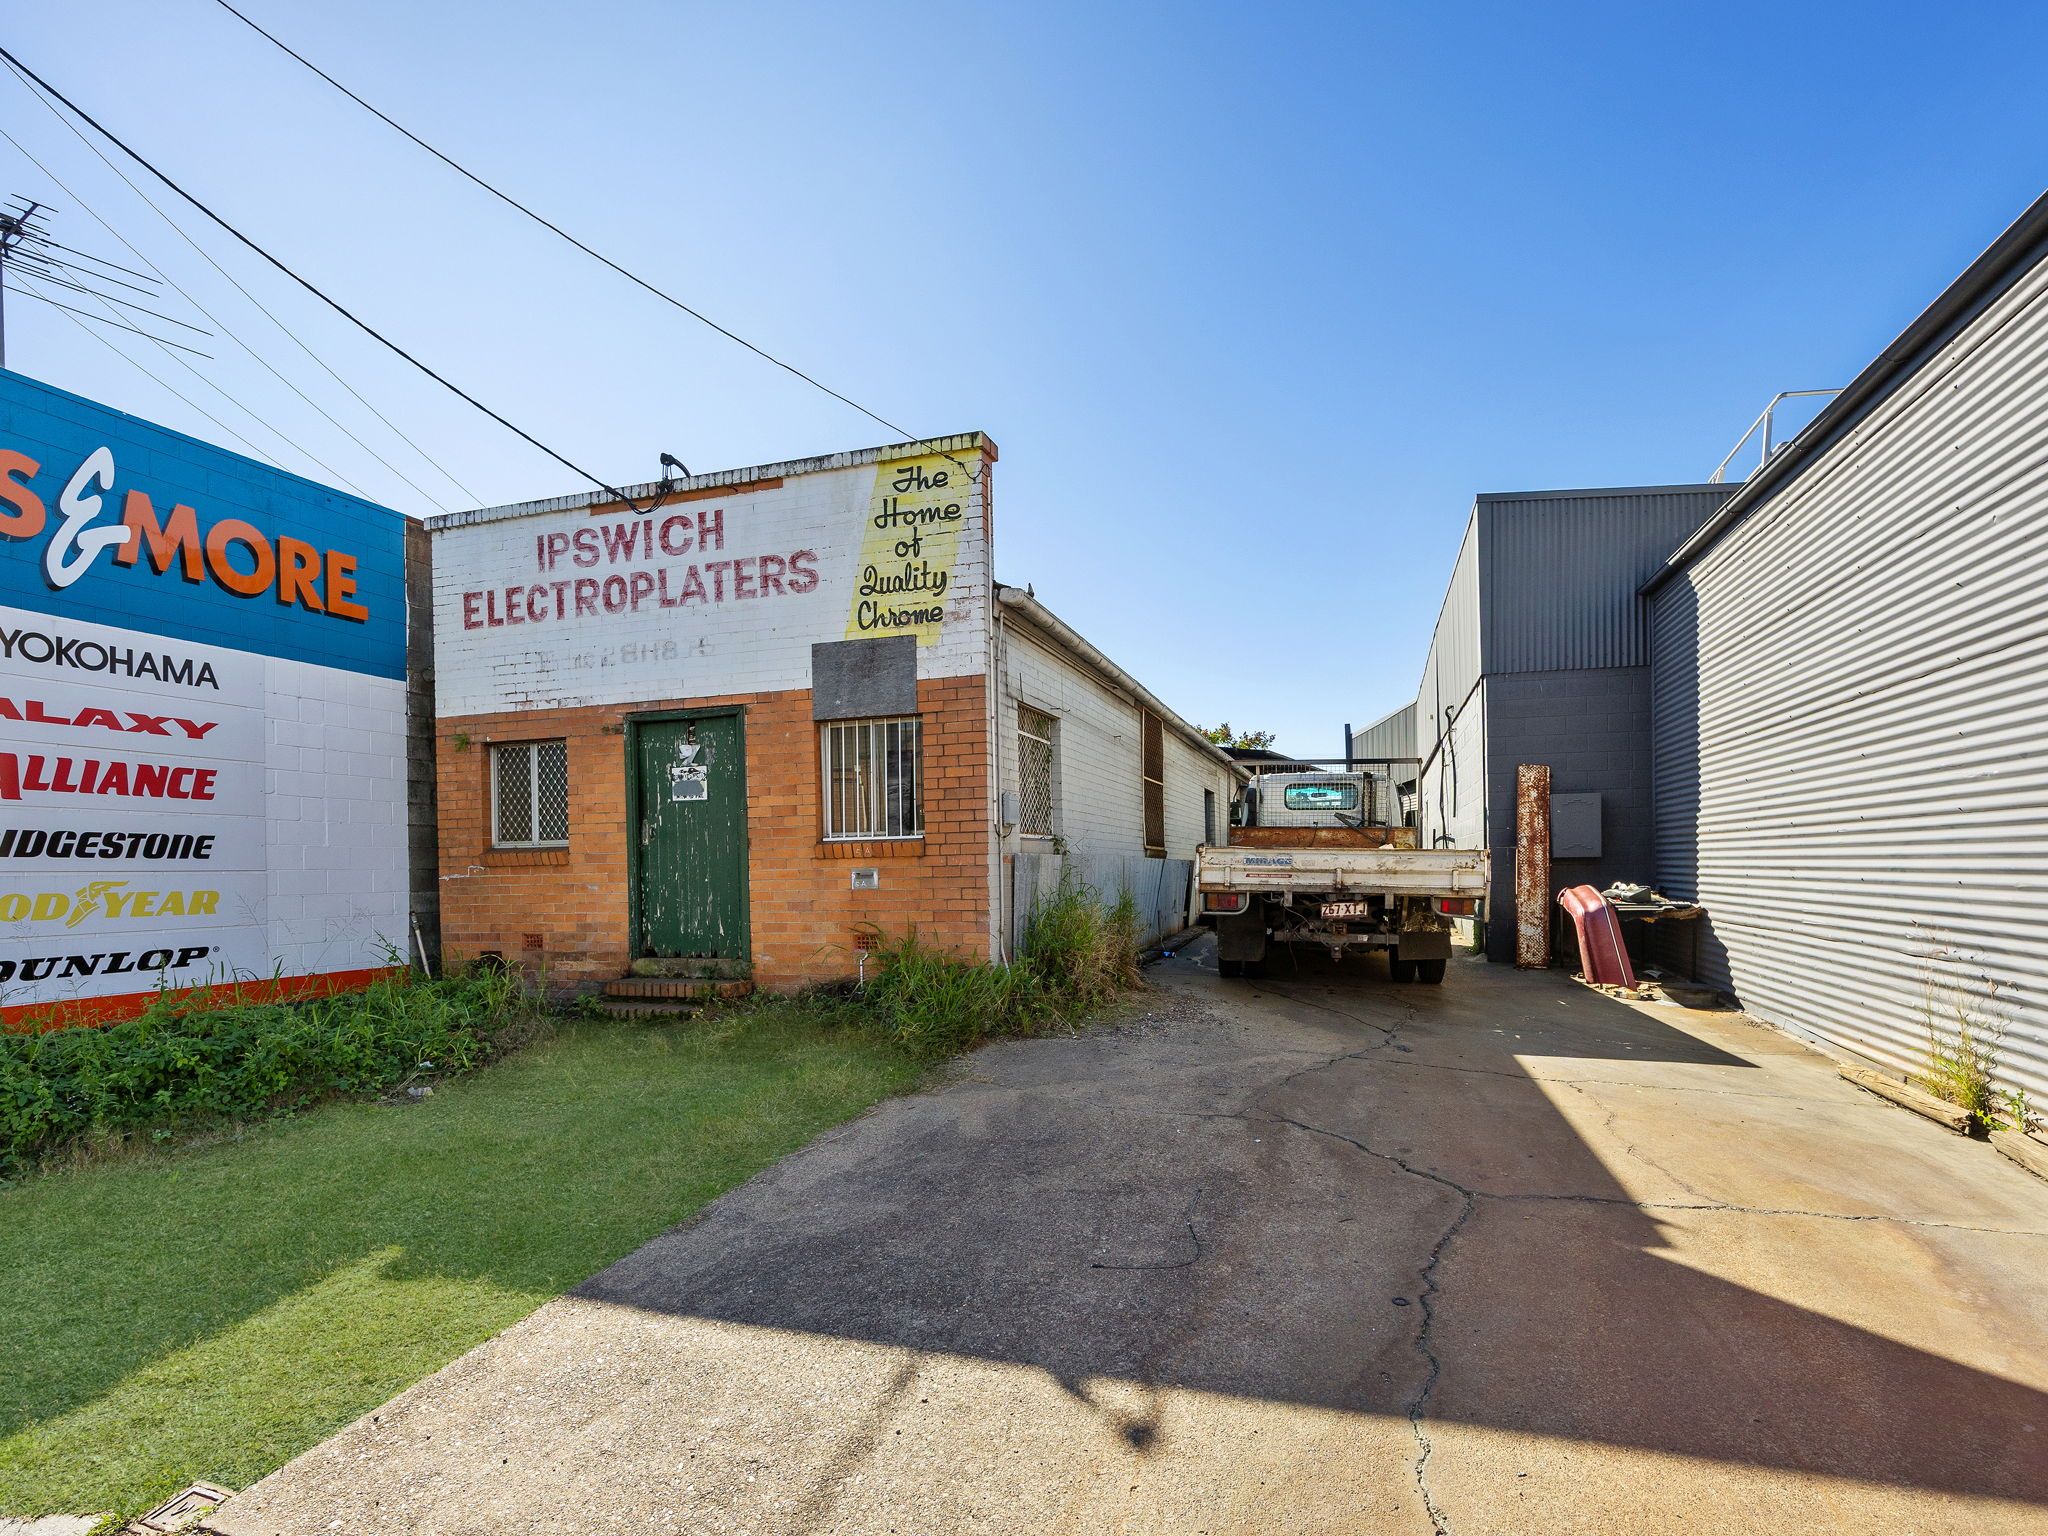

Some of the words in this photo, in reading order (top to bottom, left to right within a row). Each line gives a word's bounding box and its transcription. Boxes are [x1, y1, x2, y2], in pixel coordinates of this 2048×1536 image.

[892, 465, 949, 493] The
[874, 497, 962, 529] Home
[115, 489, 369, 622] MORE
[536, 509, 724, 574] IPSWICH
[894, 527, 923, 558] of
[462, 549, 820, 631] ELECTROPLATERS
[859, 560, 948, 597] Quality
[857, 600, 944, 631] Chrome
[0, 627, 219, 690] YOKOHAMA
[0, 829, 215, 860] IDGESTONE
